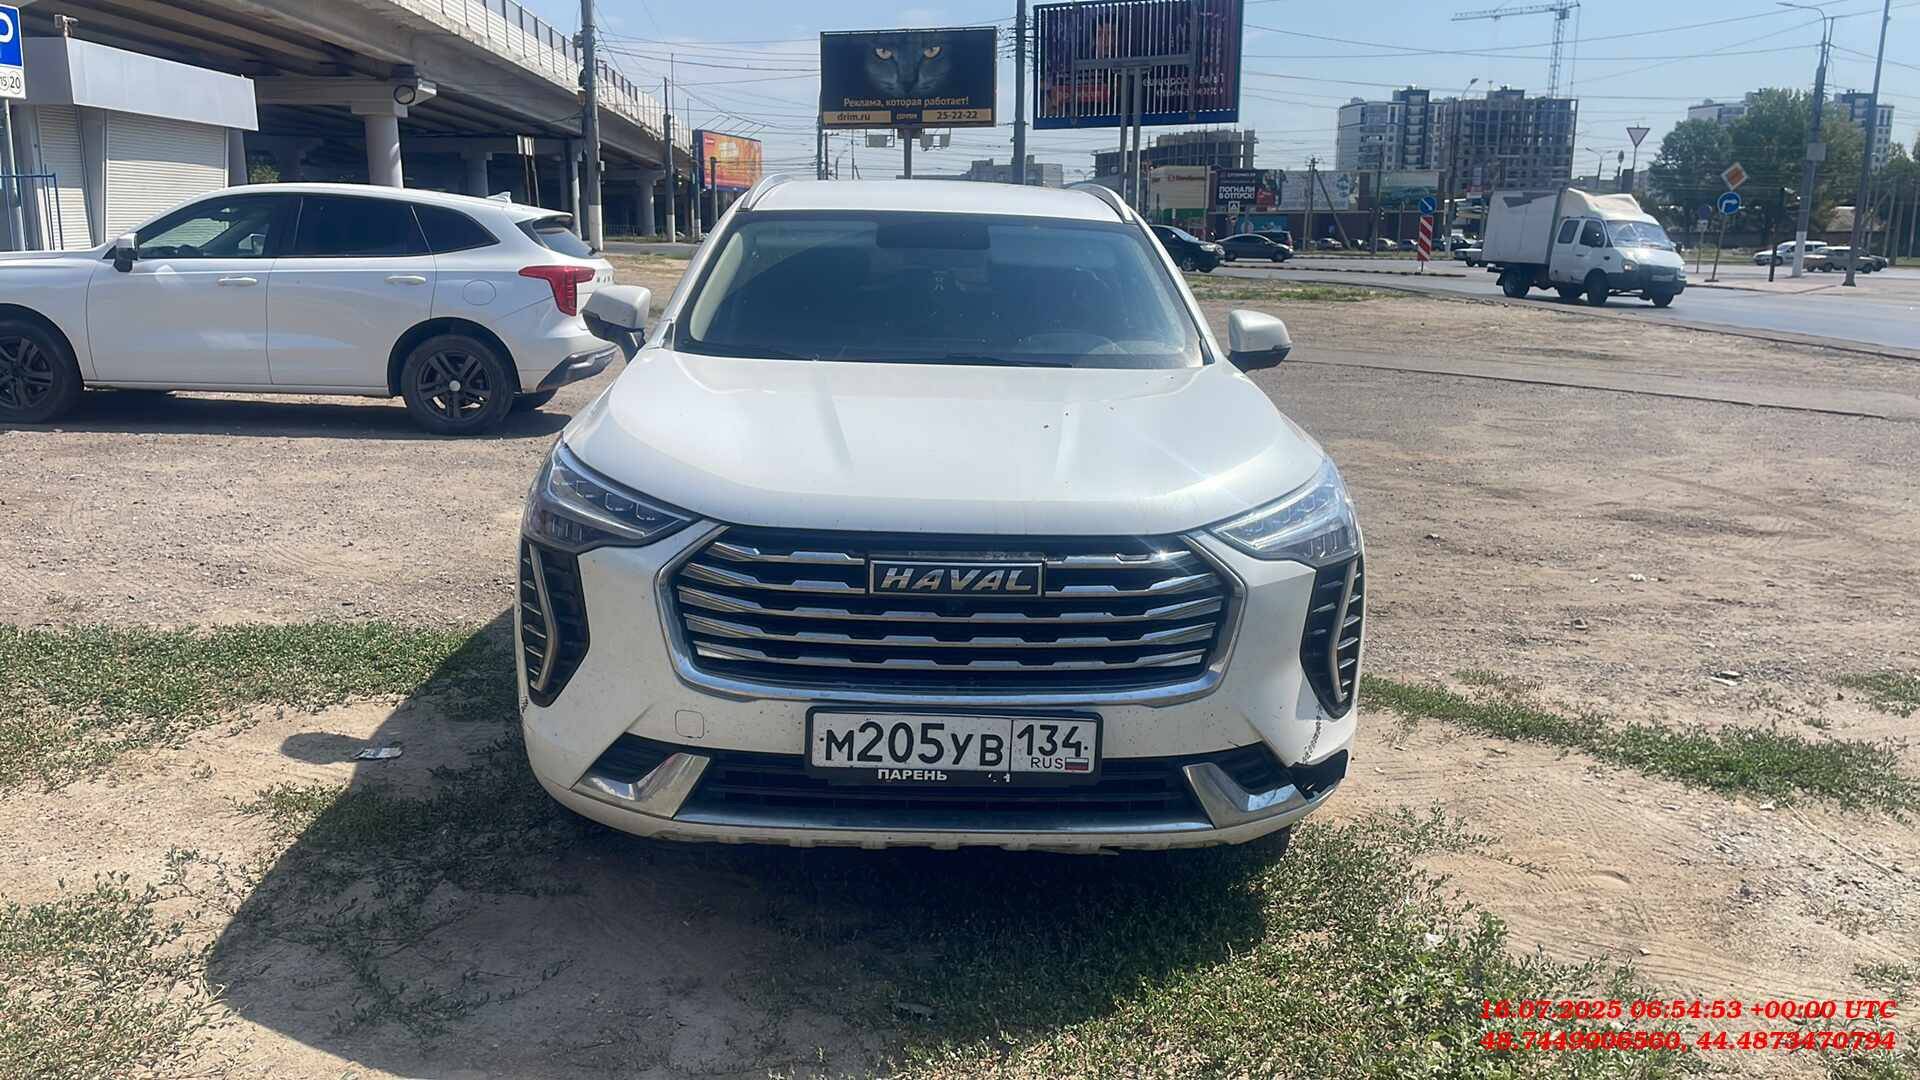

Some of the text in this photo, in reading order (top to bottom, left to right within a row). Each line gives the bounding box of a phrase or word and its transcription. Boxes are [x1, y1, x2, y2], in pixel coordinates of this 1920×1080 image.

[10, 76, 21, 89] 20
[843, 96, 969, 108] Реклама, которая работает!
[837, 113, 871, 121] drim.ru
[936, 111, 978, 120] 25-22-22
[1218, 185, 1255, 194] ПОГНАЛИ
[880, 568, 1031, 591] HAVAL
[1017, 724, 1082, 757] 134
[1030, 757, 1064, 769] RUS
[877, 769, 948, 781] ПАРЕНЬ
